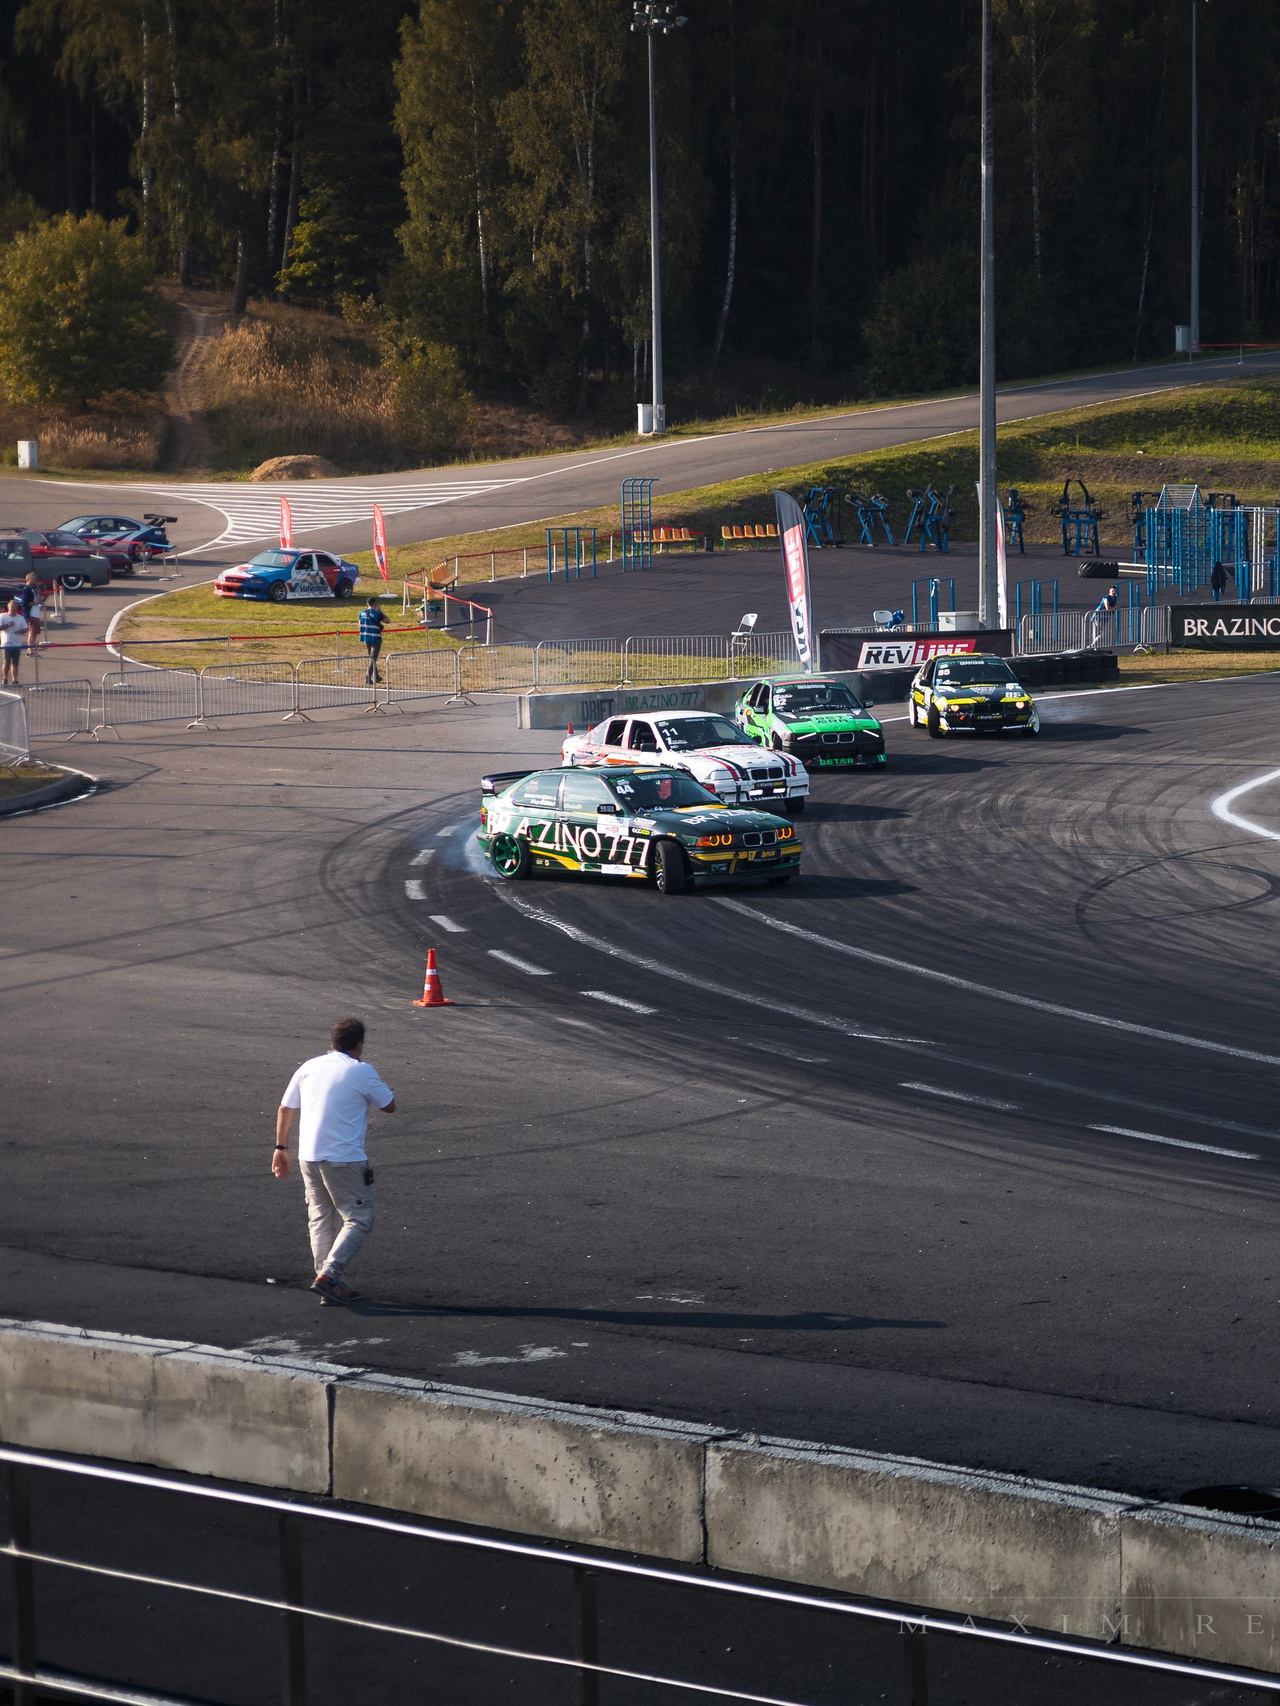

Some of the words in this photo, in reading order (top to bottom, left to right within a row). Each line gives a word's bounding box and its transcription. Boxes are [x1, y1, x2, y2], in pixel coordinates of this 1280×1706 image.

[773, 698, 787, 707] 92
[581, 698, 614, 722] DRIFT
[662, 727, 678, 737] 11
[615, 783, 635, 795] 44
